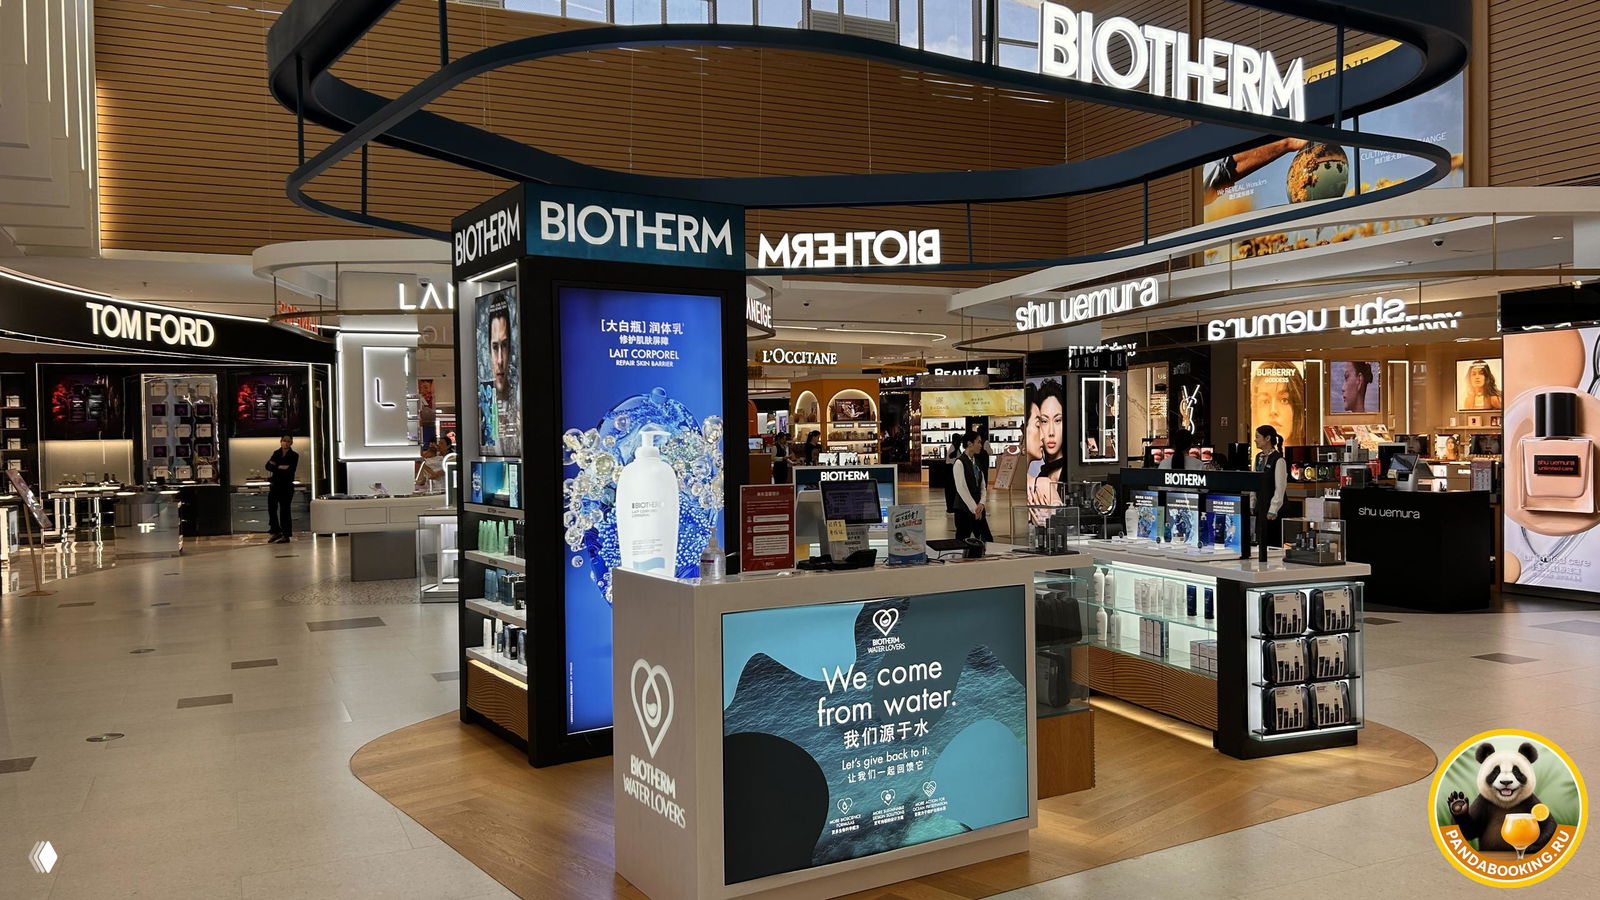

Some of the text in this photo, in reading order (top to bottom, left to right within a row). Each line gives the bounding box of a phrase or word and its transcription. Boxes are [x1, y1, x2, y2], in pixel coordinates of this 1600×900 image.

[1039, 1, 1306, 122] BIOTHERM
[455, 203, 521, 266] BIOTHERM
[540, 200, 733, 256] BIOTHERM
[746, 297, 772, 328] ANEIGE
[1016, 277, 1159, 332] shu uemura
[86, 301, 215, 347] TOM FORD
[609, 348, 680, 360] LAIT CORPOREL
[762, 348, 837, 365] L'OCCITANE
[1257, 368, 1296, 376] BURBERRY
[820, 470, 869, 481] BIOTHERM
[1164, 472, 1207, 487] BIOTHERM
[1358, 506, 1420, 519] shu uemura
[137, 523, 155, 533] TF
[867, 643, 906, 654] WATER LOVERS
[872, 636, 900, 646] BIOTHERM
[822, 661, 942, 694] We come
[817, 688, 957, 727] from water.
[843, 718, 929, 749] 我们源于水
[842, 746, 930, 771] Let's give back to it.
[847, 760, 924, 783] 让我们一起回馈它
[630, 754, 676, 799] BIOTHERM
[623, 773, 686, 829] WATER LOVERS
